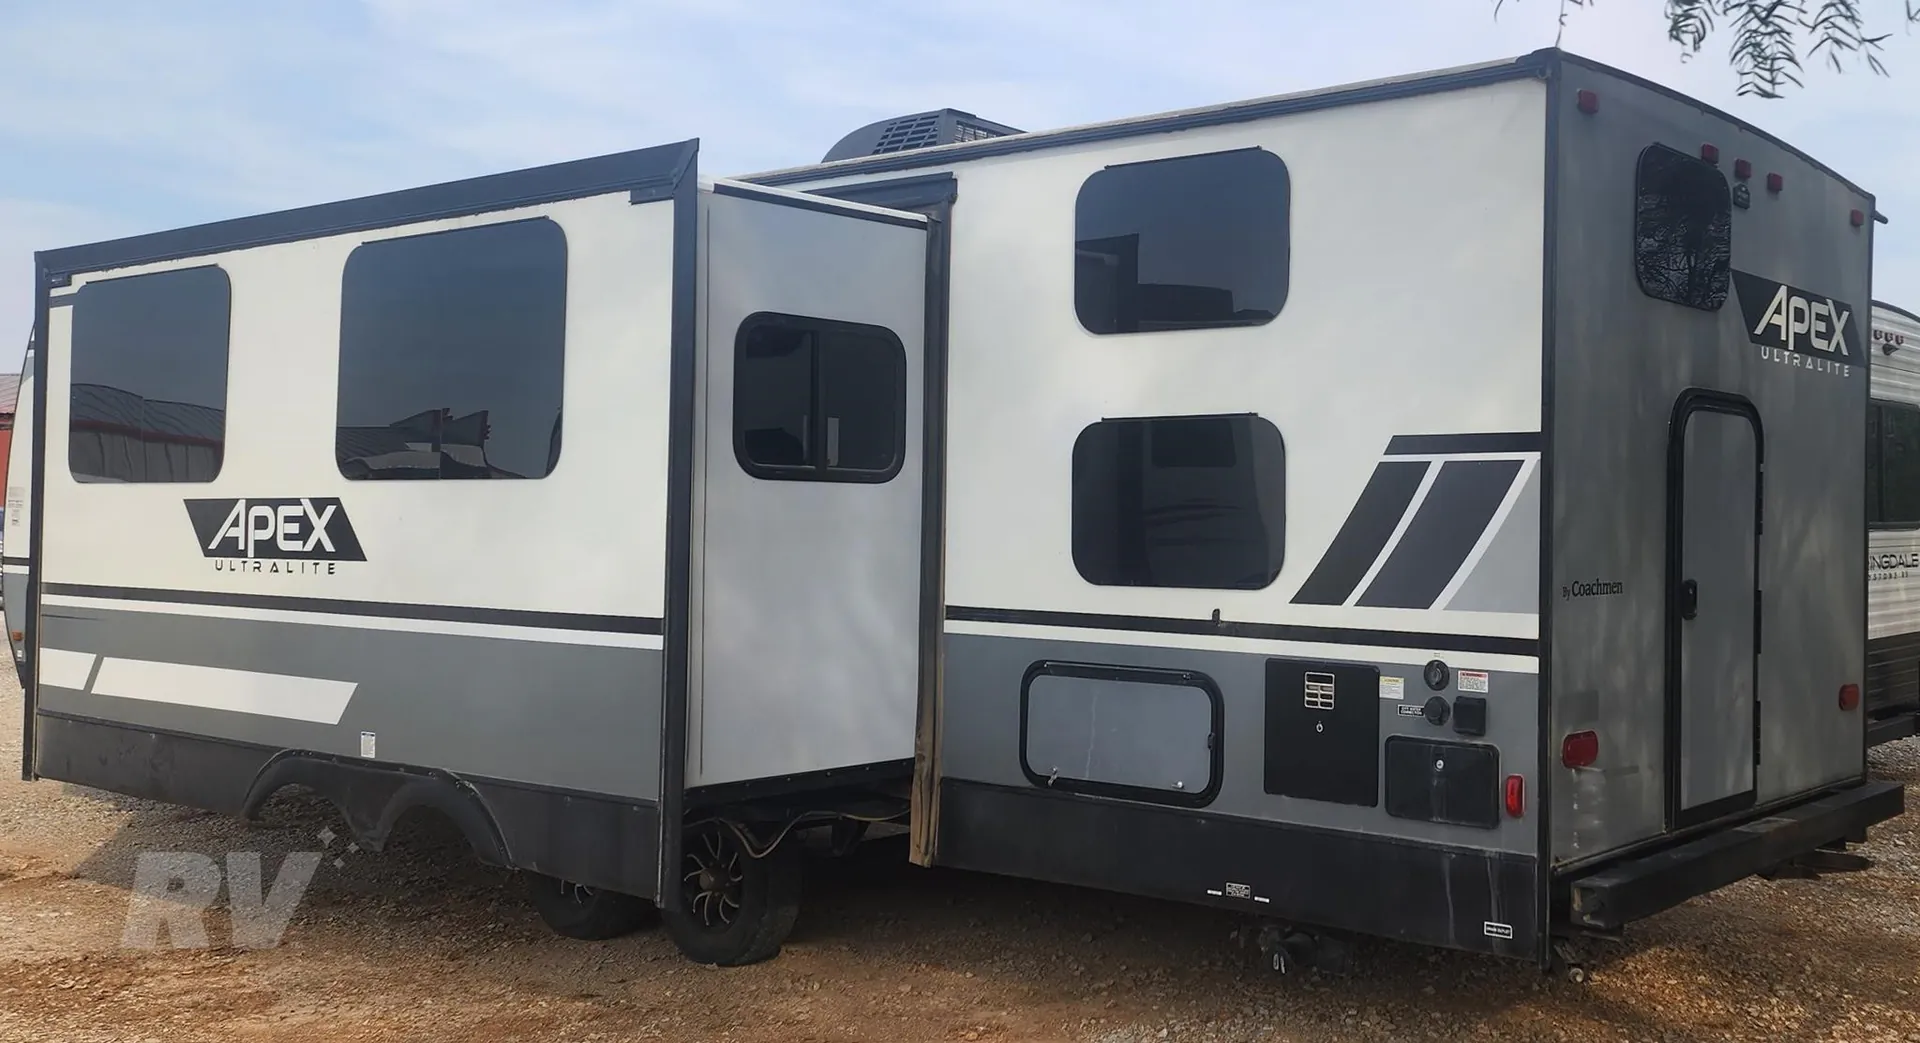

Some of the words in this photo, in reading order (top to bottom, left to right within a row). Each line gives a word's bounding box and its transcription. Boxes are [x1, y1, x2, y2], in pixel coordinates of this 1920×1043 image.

[1753, 284, 1850, 356] APEX
[1761, 346, 1850, 378] ULTRALITE
[208, 498, 337, 558] APEX
[215, 560, 336, 575] ULTRALITE
[1562, 586, 1571, 601] By
[1571, 577, 1623, 598] Coachmen
